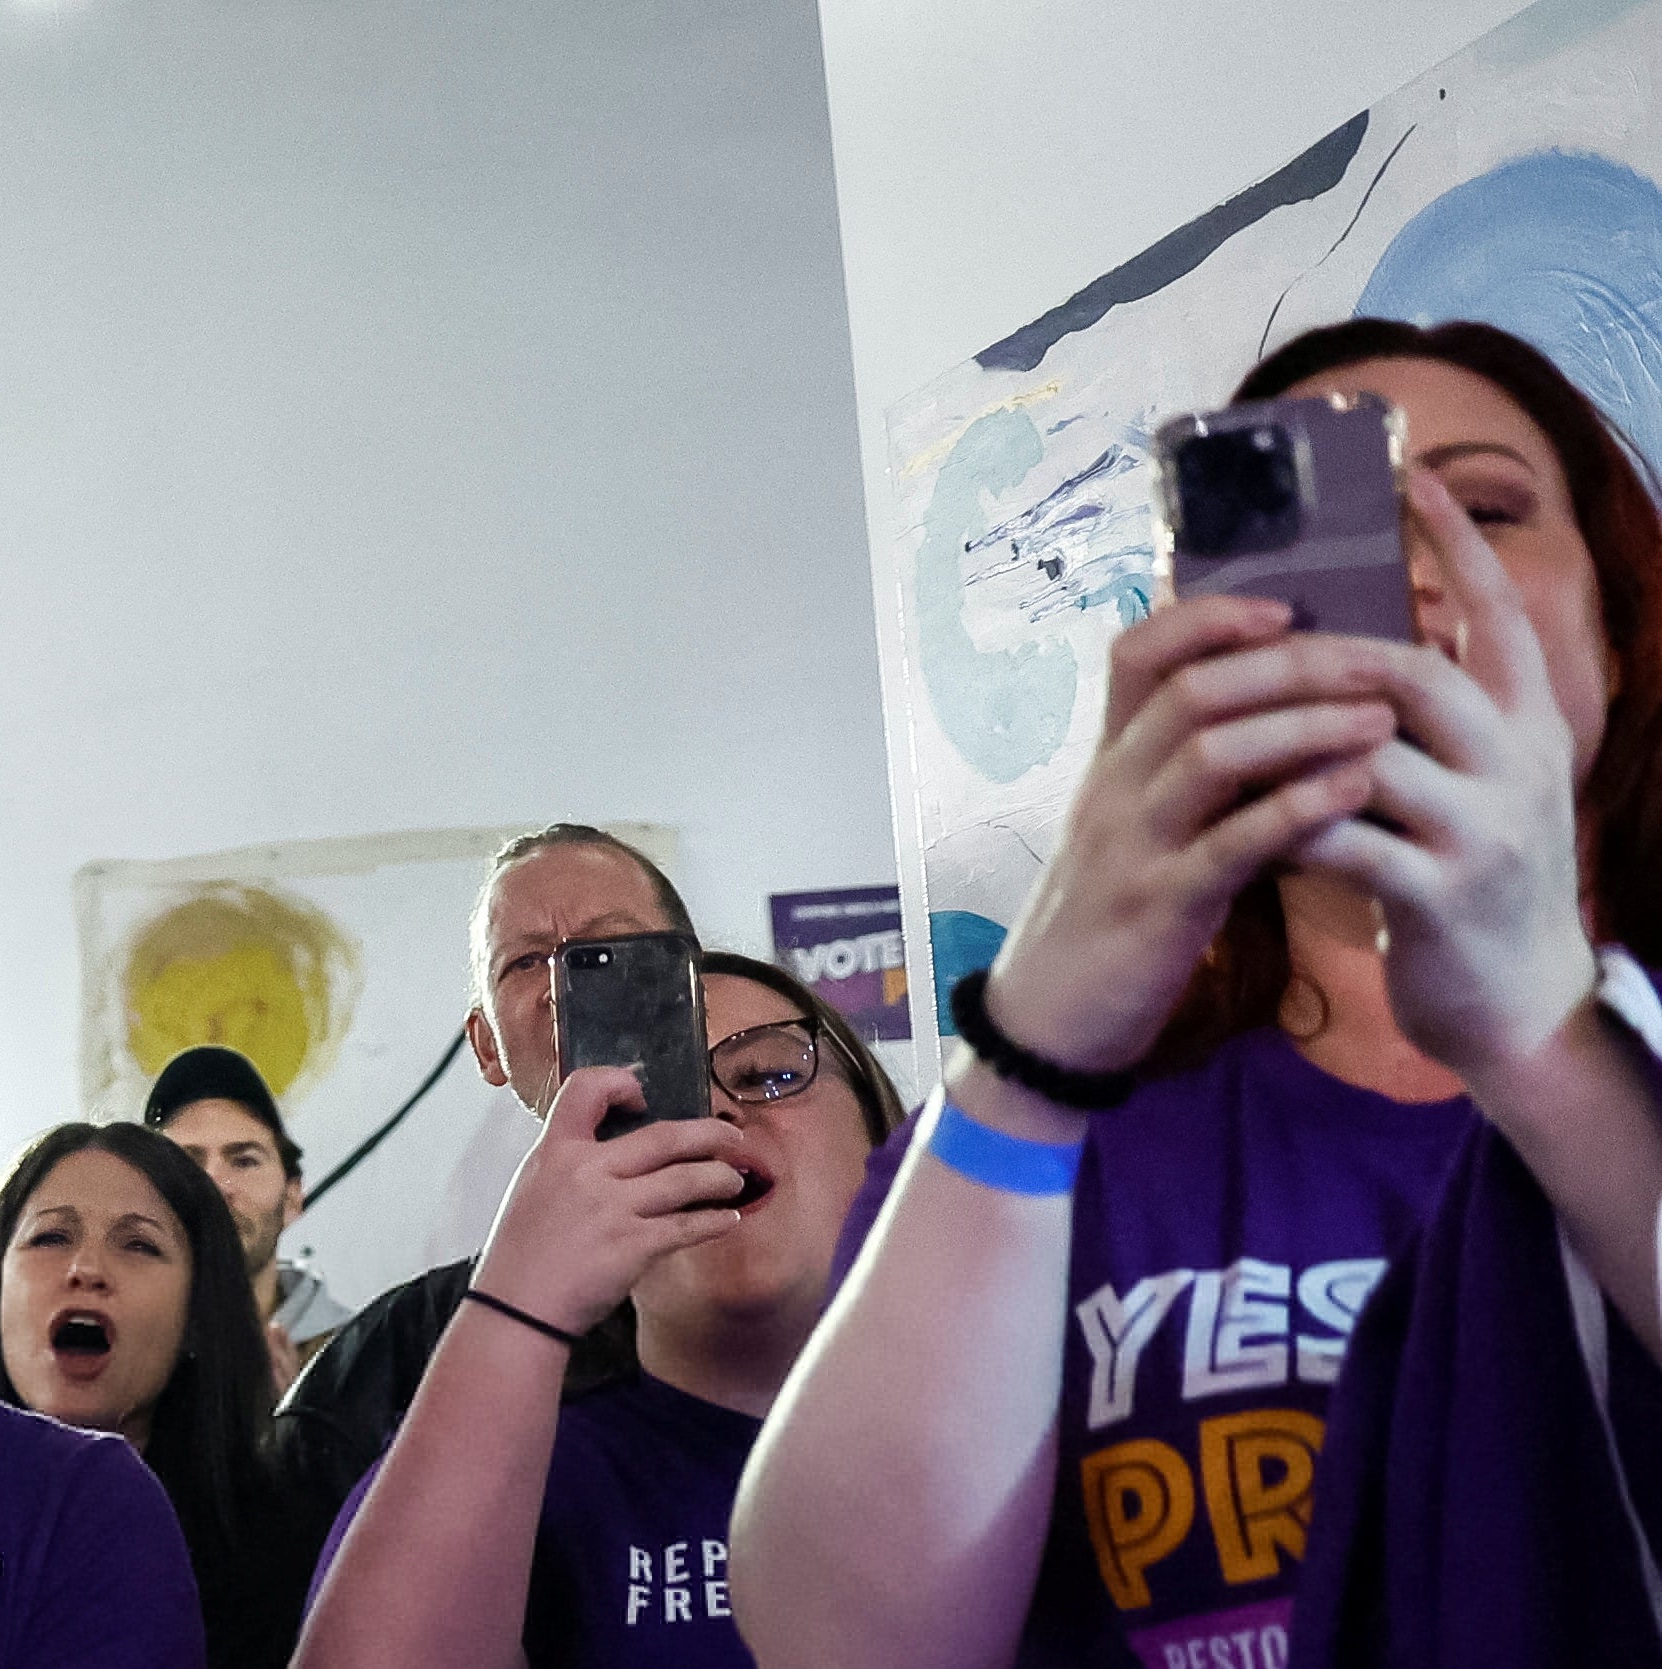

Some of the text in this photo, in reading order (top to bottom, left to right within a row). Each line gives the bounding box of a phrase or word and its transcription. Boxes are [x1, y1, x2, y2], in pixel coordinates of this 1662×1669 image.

[791, 928, 905, 985] VOTE
[1076, 1256, 1389, 1431] YES
[1080, 1409, 1325, 1610] PR
[628, 1539, 728, 1583] REP
[627, 1580, 733, 1625] FRE
